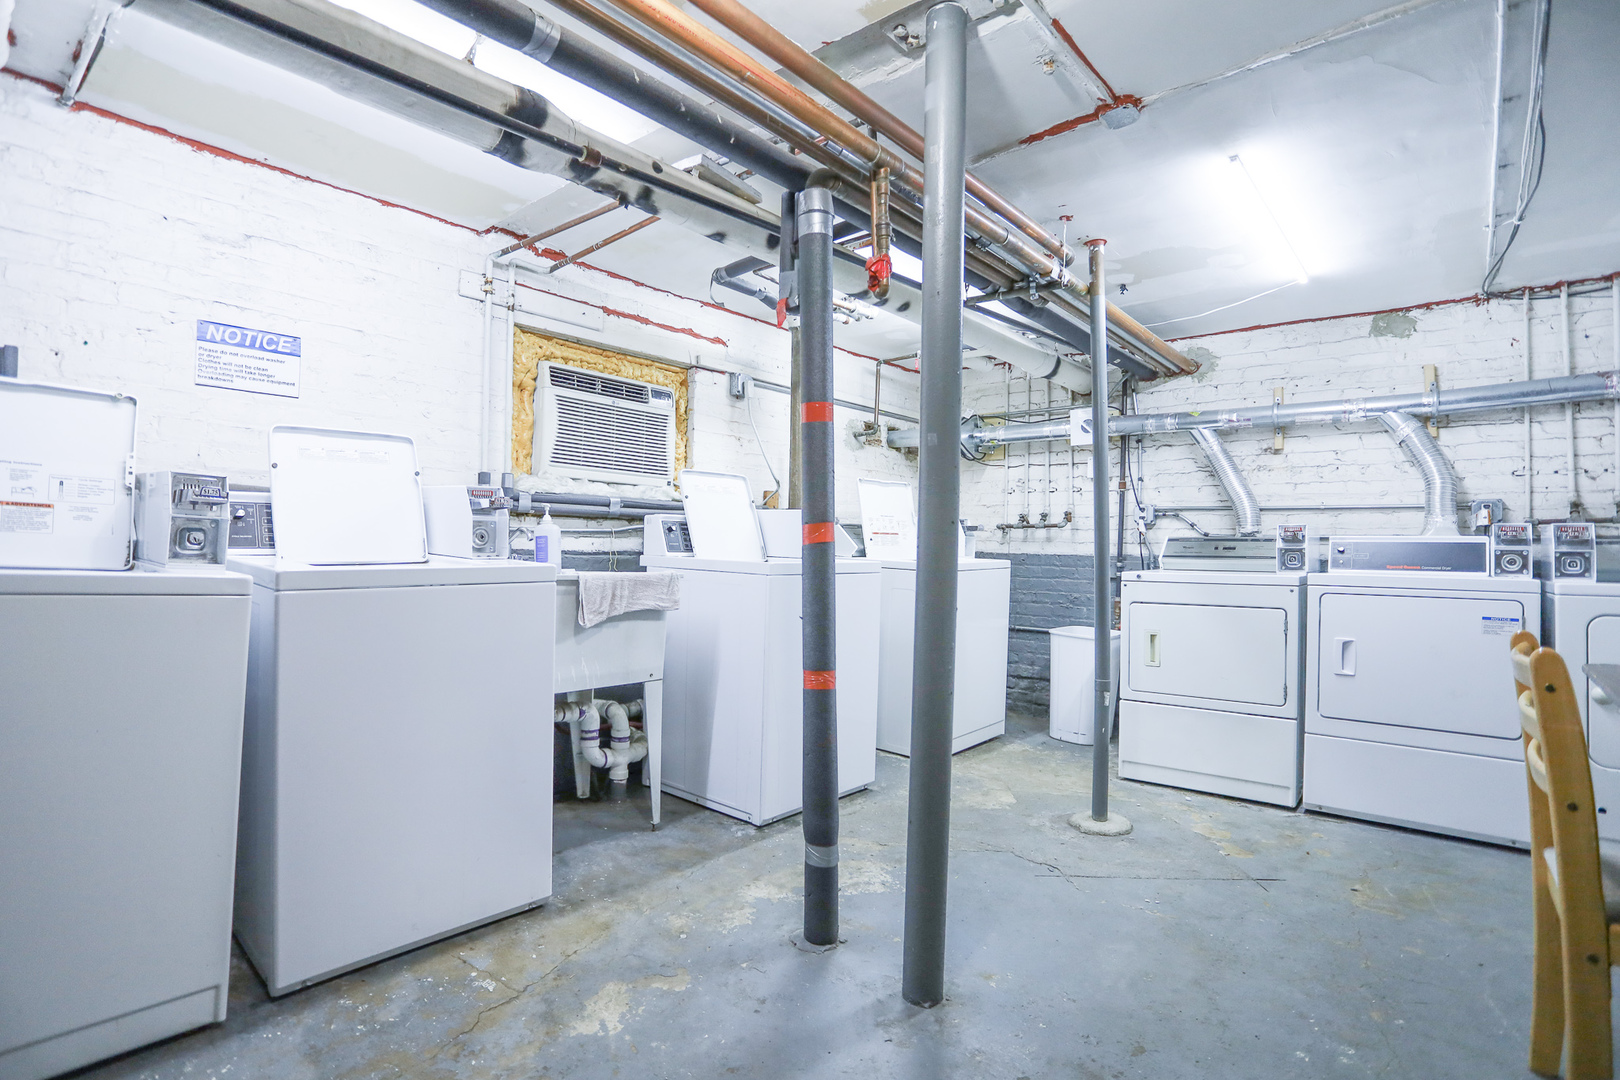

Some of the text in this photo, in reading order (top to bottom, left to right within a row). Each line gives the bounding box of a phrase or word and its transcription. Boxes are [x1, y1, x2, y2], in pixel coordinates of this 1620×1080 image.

[206, 324, 293, 353] NOTICE
[198, 346, 218, 354] Please
[240, 353, 264, 361] overload
[198, 357, 221, 365] Clothes
[198, 362, 218, 371] Drying
[198, 368, 234, 378] Overloading
[198, 374, 234, 383] breakdowns
